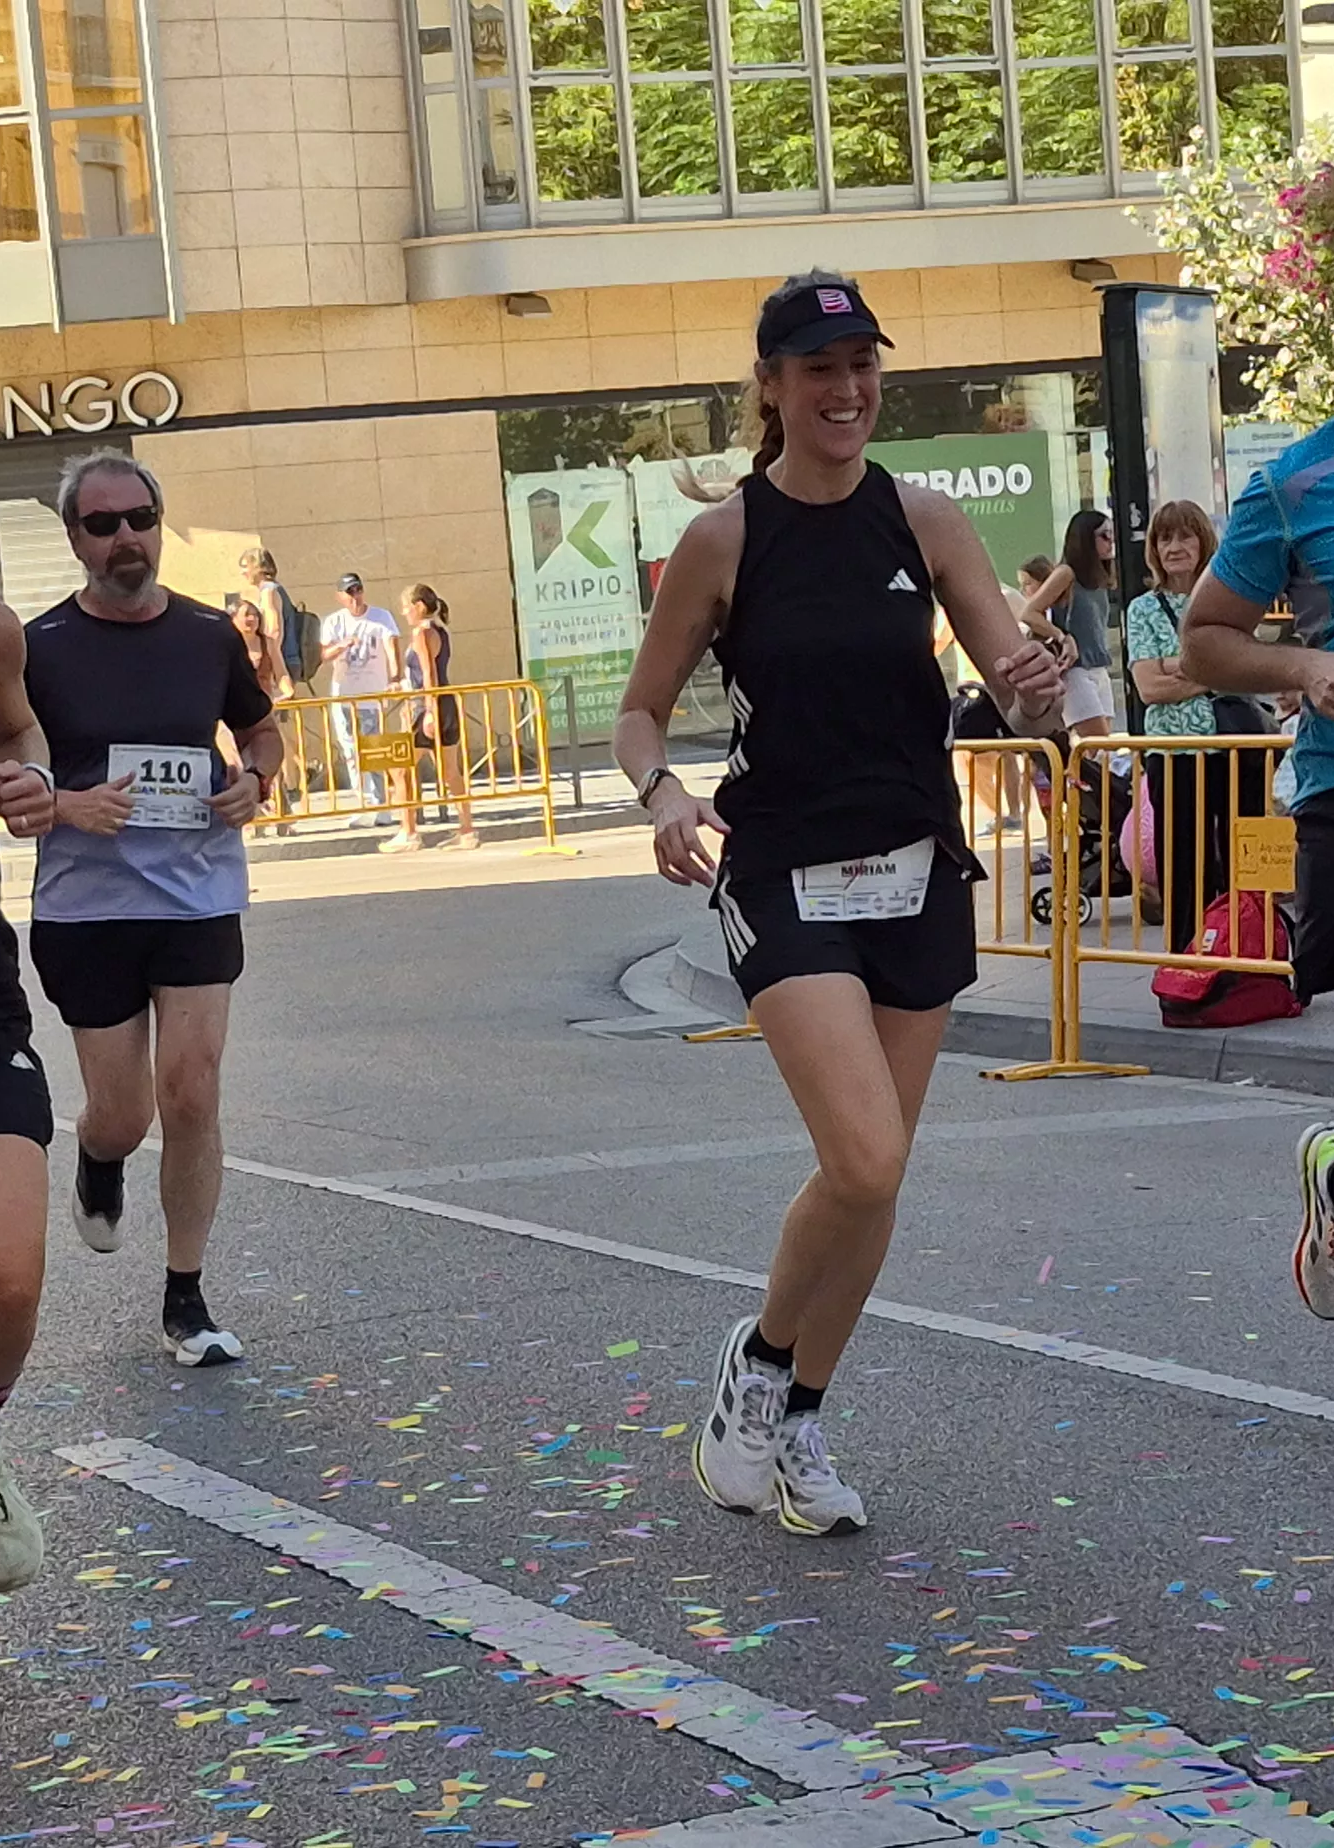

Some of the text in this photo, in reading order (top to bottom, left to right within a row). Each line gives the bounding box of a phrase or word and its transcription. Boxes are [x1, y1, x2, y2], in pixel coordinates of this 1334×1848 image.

[535, 574, 621, 602] KRIPIO
[140, 759, 192, 784] 110
[841, 863, 896, 878] MIRIAM
